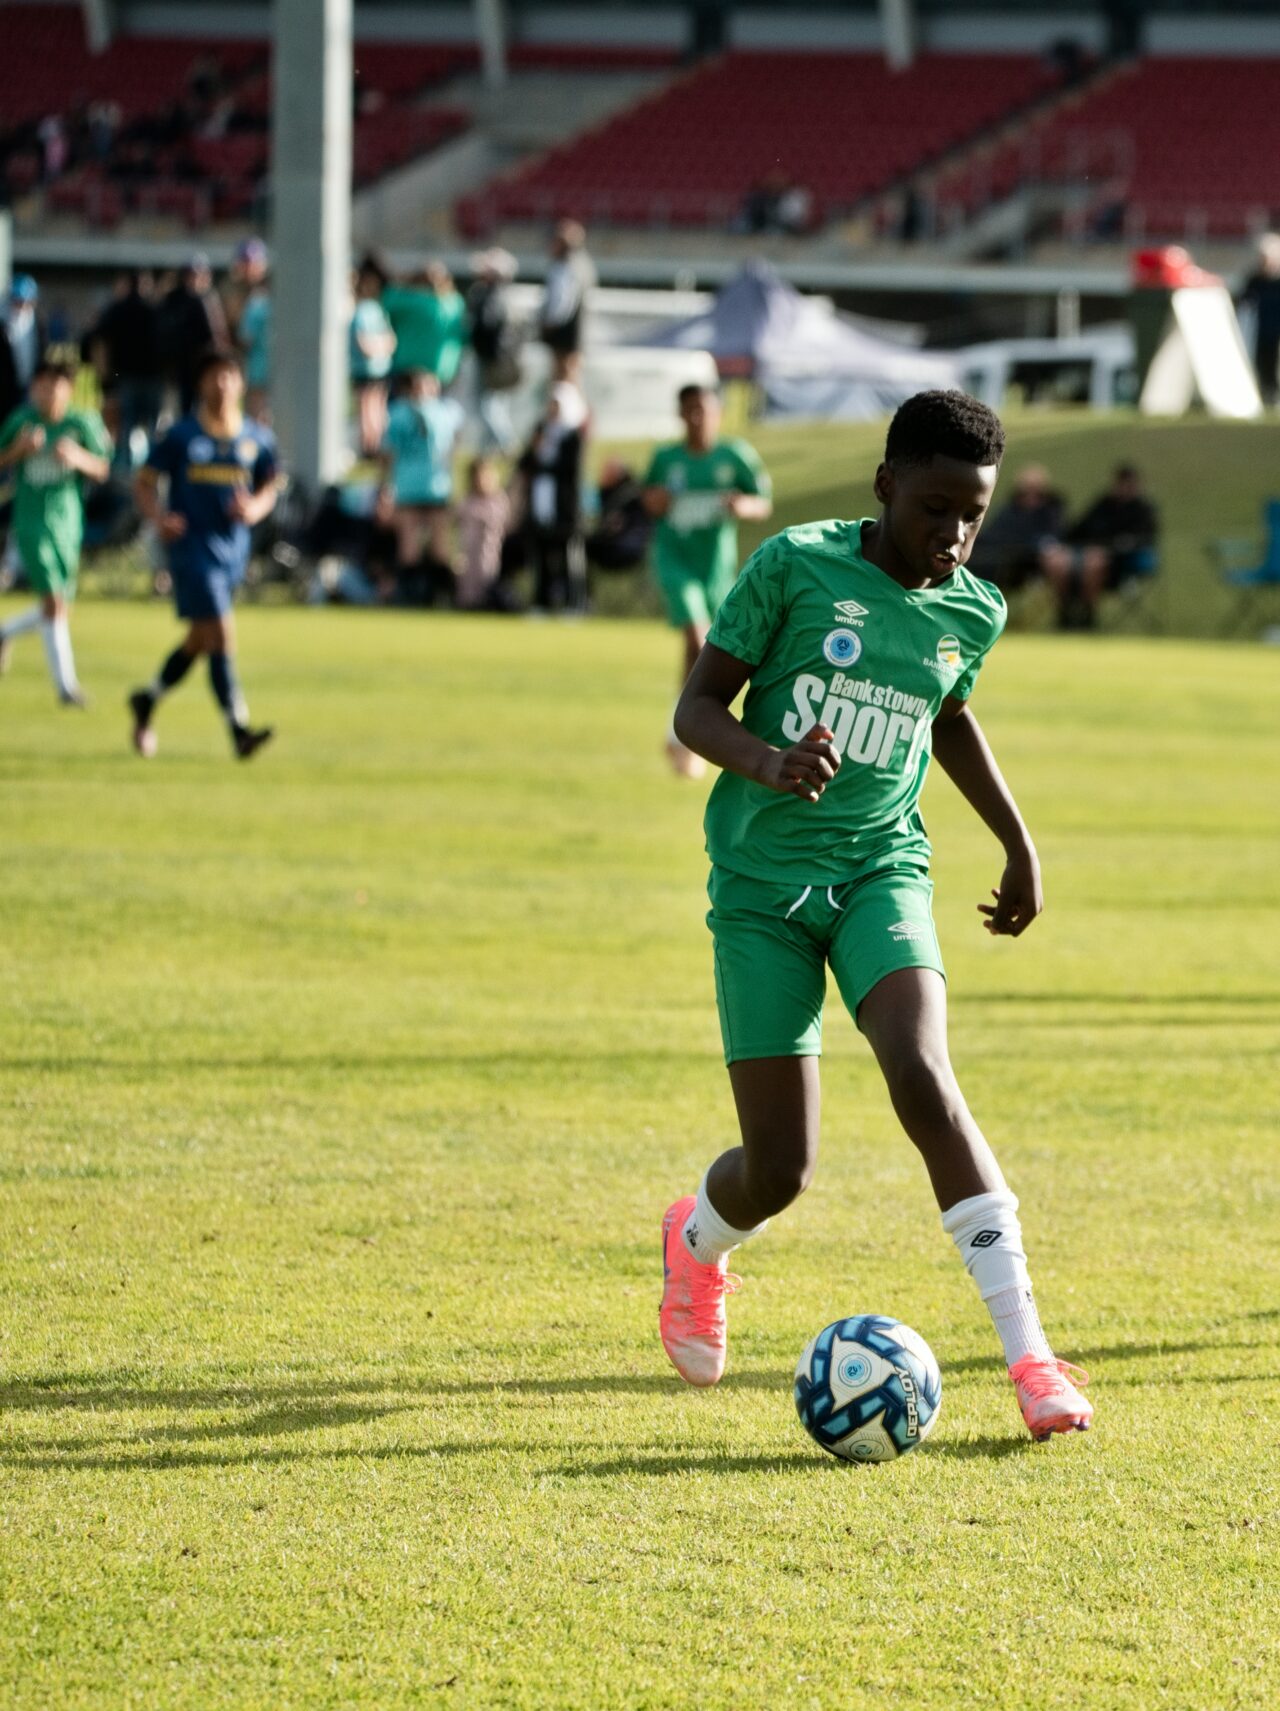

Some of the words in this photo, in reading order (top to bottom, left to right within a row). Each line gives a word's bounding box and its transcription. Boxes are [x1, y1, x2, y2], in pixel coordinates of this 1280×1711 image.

[834, 614, 865, 628] umbro
[829, 672, 928, 717] Bankstown
[894, 1365, 918, 1437] DEPLOY
